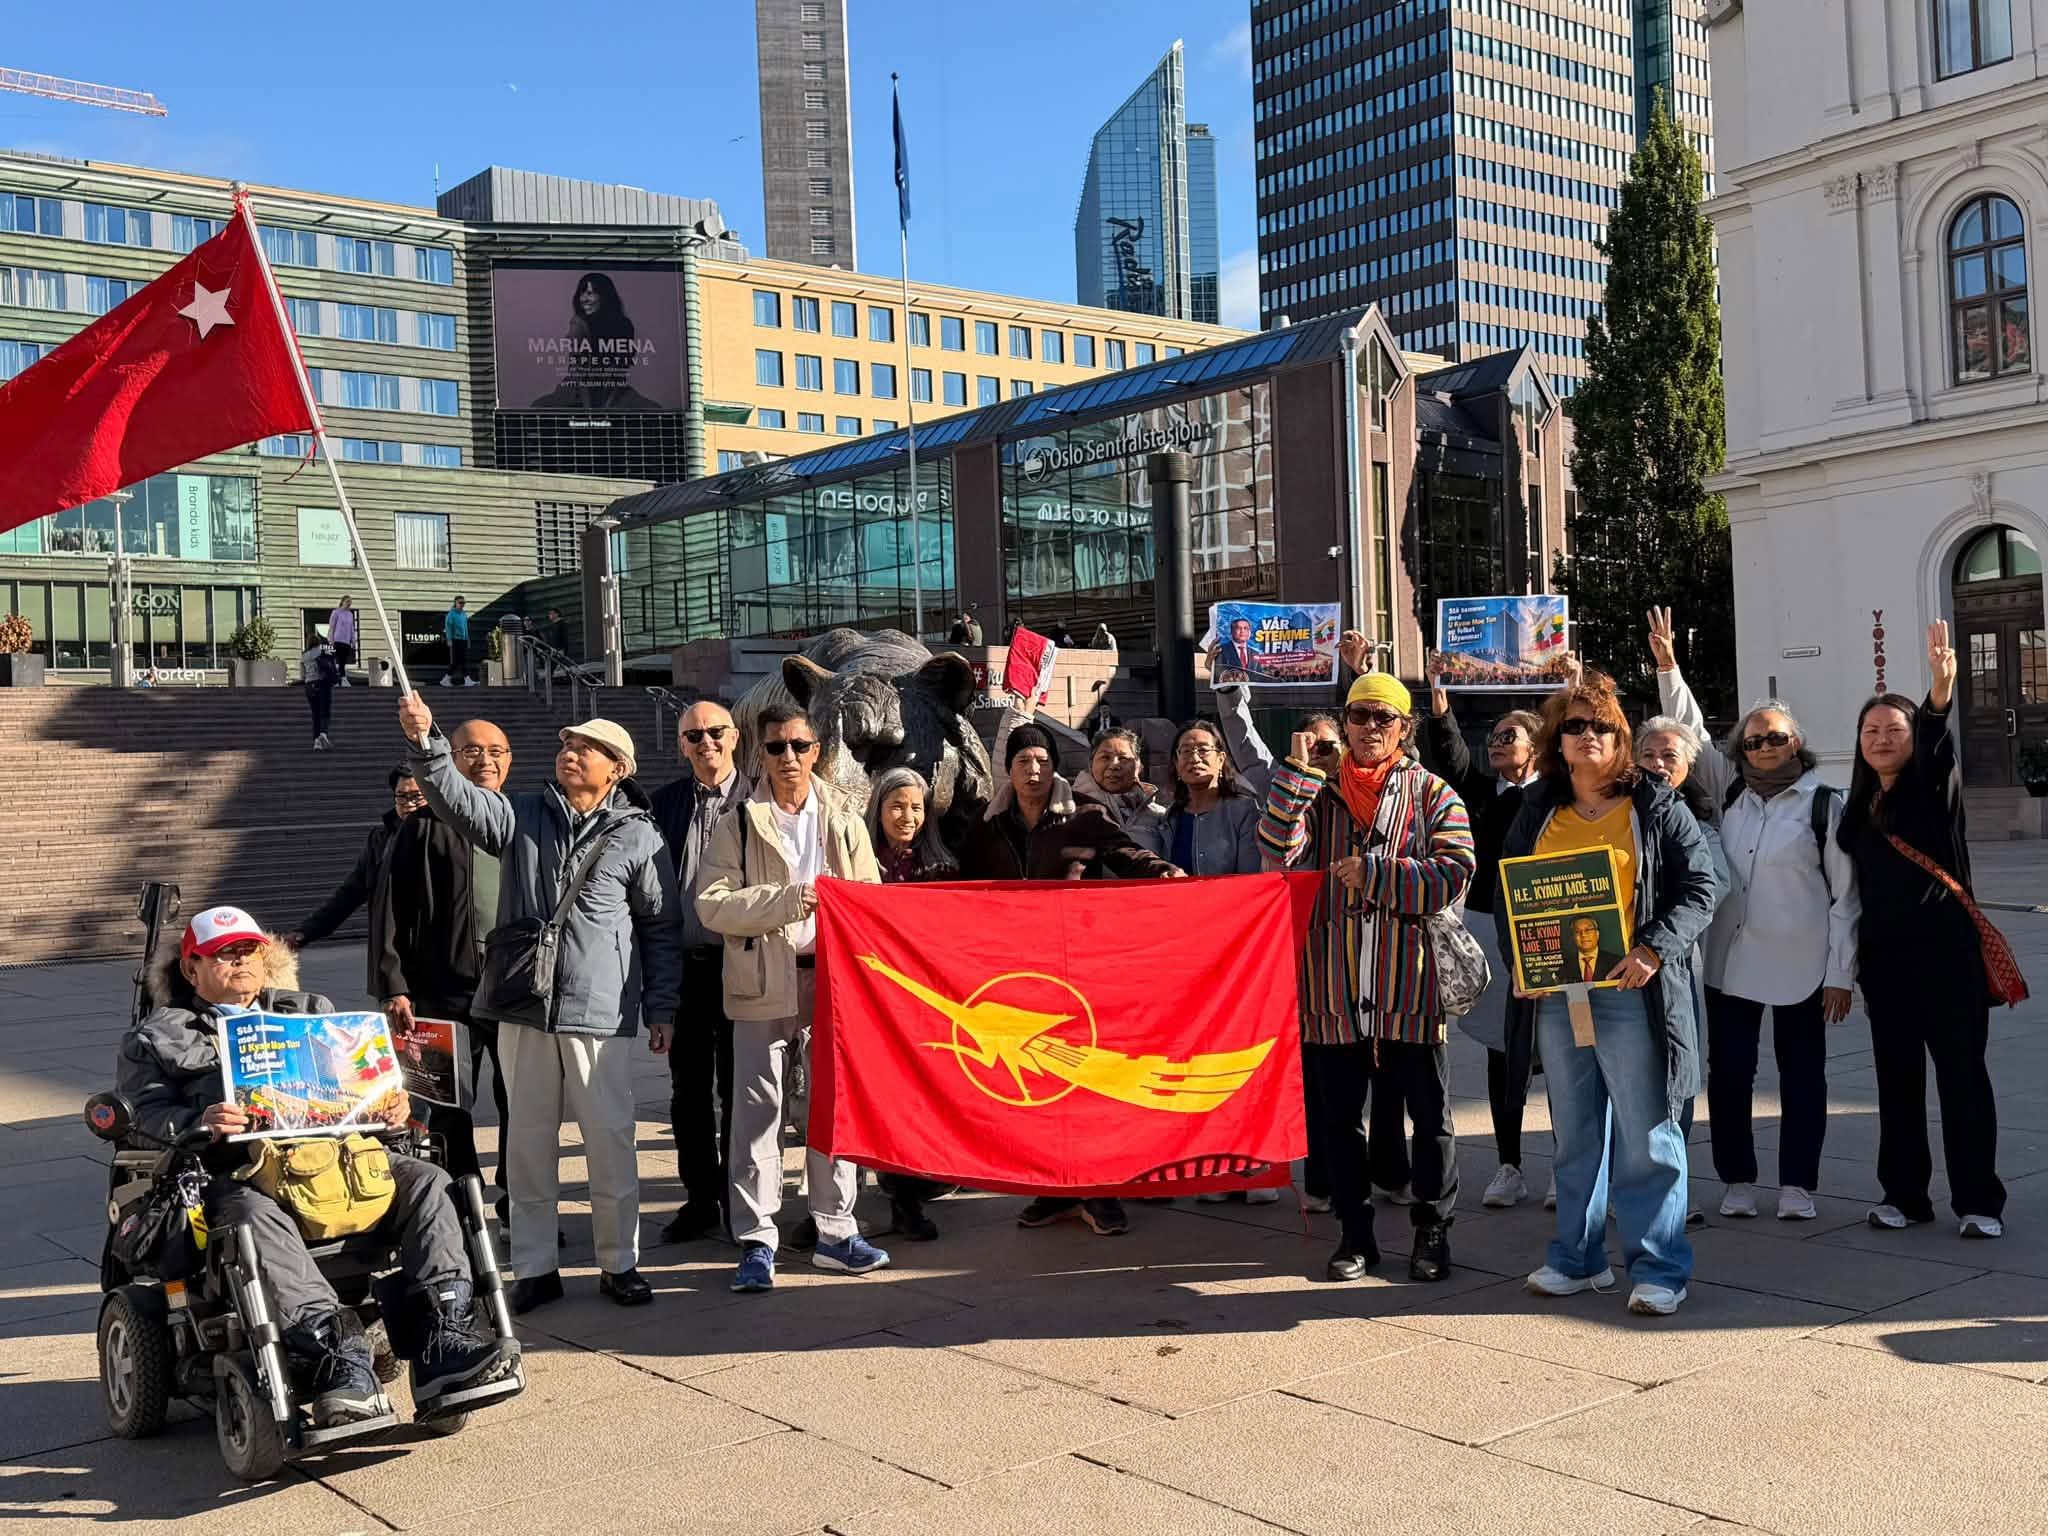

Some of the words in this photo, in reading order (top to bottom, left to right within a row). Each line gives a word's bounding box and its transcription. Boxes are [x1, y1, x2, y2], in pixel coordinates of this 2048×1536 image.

[528, 338, 592, 353] MARIA
[598, 338, 656, 353] MENA
[536, 356, 649, 366] PERSPECTIVE
[1050, 443, 1084, 469] Oslo
[1086, 421, 1201, 462] Sentralstasjon
[132, 593, 180, 609] GON
[1261, 616, 1289, 631] VÅR
[1255, 629, 1310, 642] STEMME
[1264, 642, 1270, 654] I
[1272, 640, 1294, 654] FN
[1513, 888, 1533, 903] H.E.
[1534, 882, 1563, 900] KYAW
[1565, 880, 1589, 897] MOE
[1591, 877, 1610, 892] TUN
[1520, 928, 1537, 941] H.E.
[1537, 925, 1561, 939] KYAW
[1522, 940, 1541, 953] MOE
[1544, 938, 1561, 952] TUN
[236, 1023, 253, 1036] Stå
[239, 1045, 246, 1054] U
